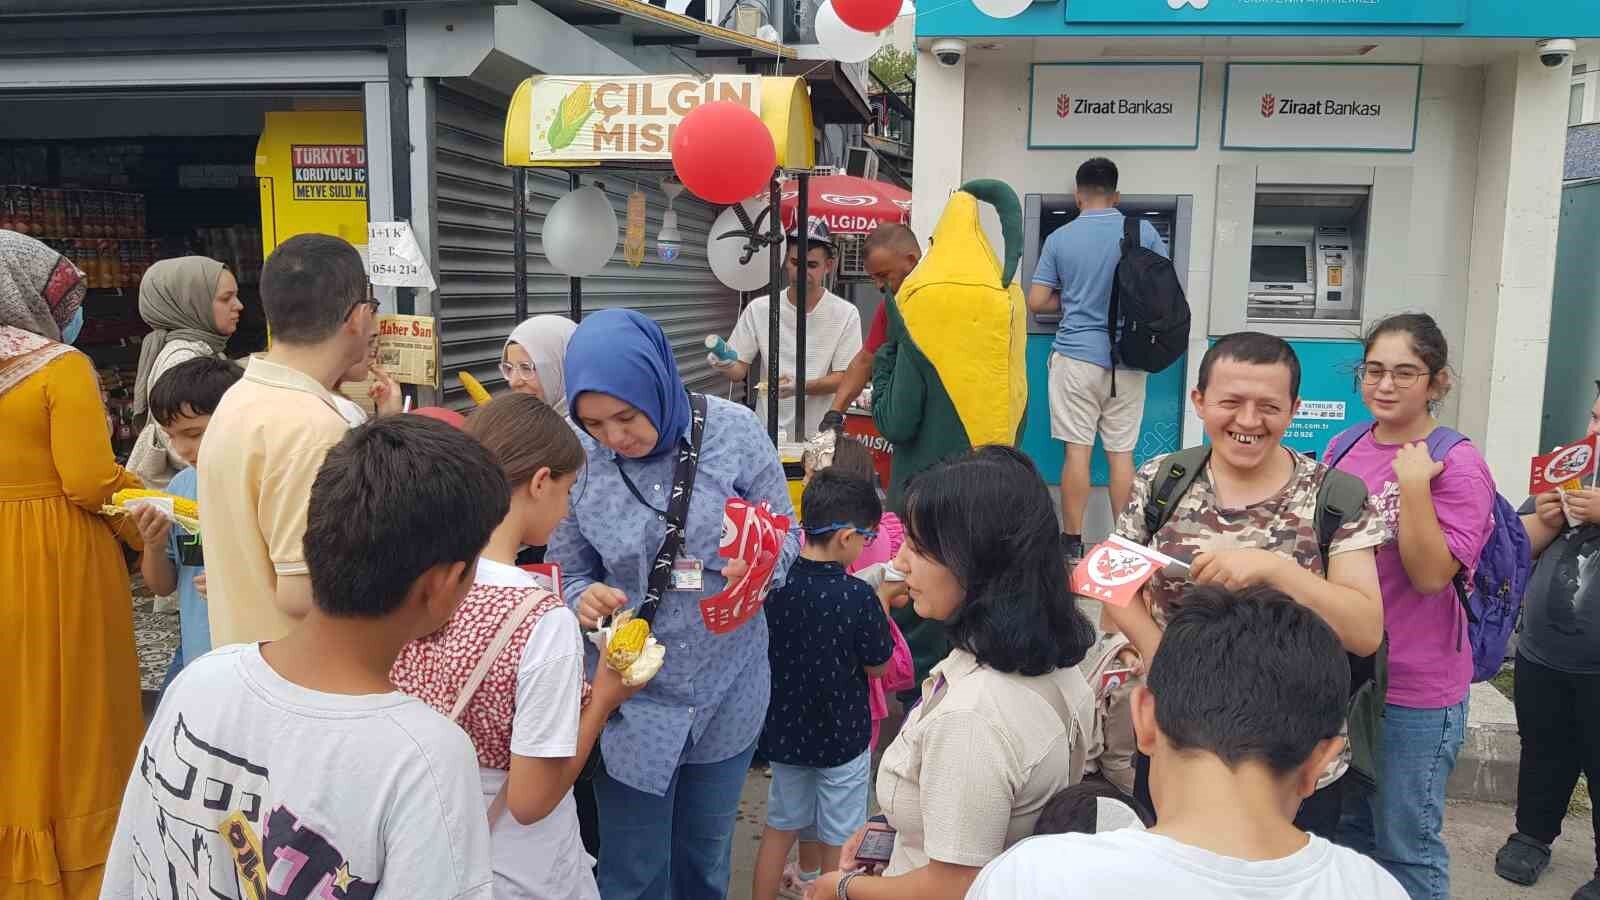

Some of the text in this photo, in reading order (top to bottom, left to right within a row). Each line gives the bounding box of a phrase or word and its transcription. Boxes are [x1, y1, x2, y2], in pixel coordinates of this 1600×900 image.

[594, 82, 752, 122] ÇILGIN
[1073, 99, 1173, 114] Ziraat Bankası
[1279, 99, 1381, 117] Ziraat Bankası
[295, 167, 353, 181] KORUYUCU
[296, 184, 328, 198] MEYVE
[329, 184, 352, 198] SULU
[399, 264, 417, 274] 214
[379, 319, 409, 337] Haber
